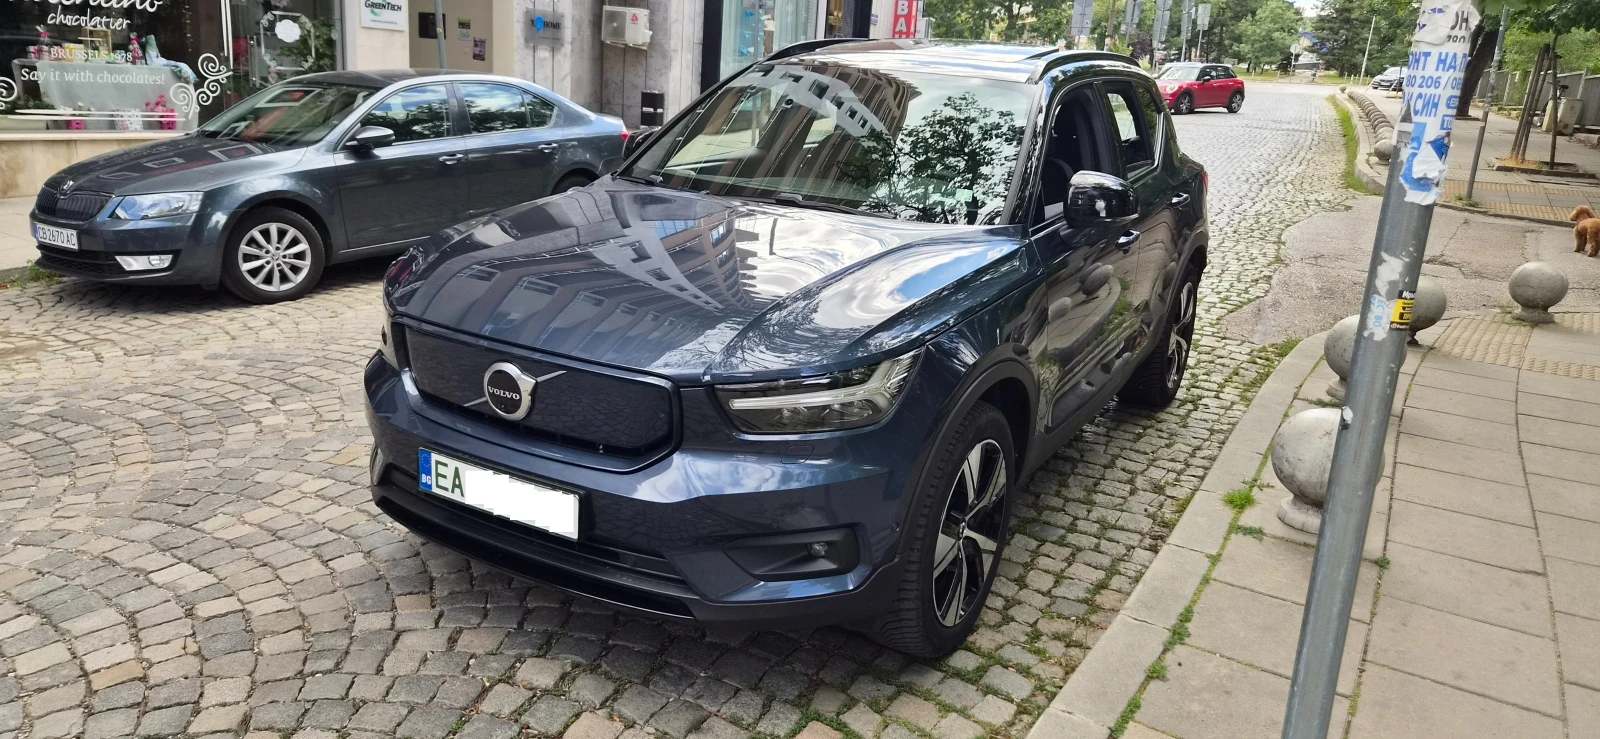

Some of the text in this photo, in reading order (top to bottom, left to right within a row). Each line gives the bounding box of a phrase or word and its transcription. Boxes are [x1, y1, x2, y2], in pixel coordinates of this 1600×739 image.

[47, 5, 132, 30] chocolatier
[50, 47, 108, 61] BRUSSELS
[20, 68, 165, 85] Say it with chocolates!
[1417, 75, 1442, 89] 206
[1412, 92, 1442, 118] СИН
[48, 229, 64, 243] 2670
[66, 232, 76, 246] AC
[487, 385, 521, 400] VOLVO
[421, 473, 432, 485] BG
